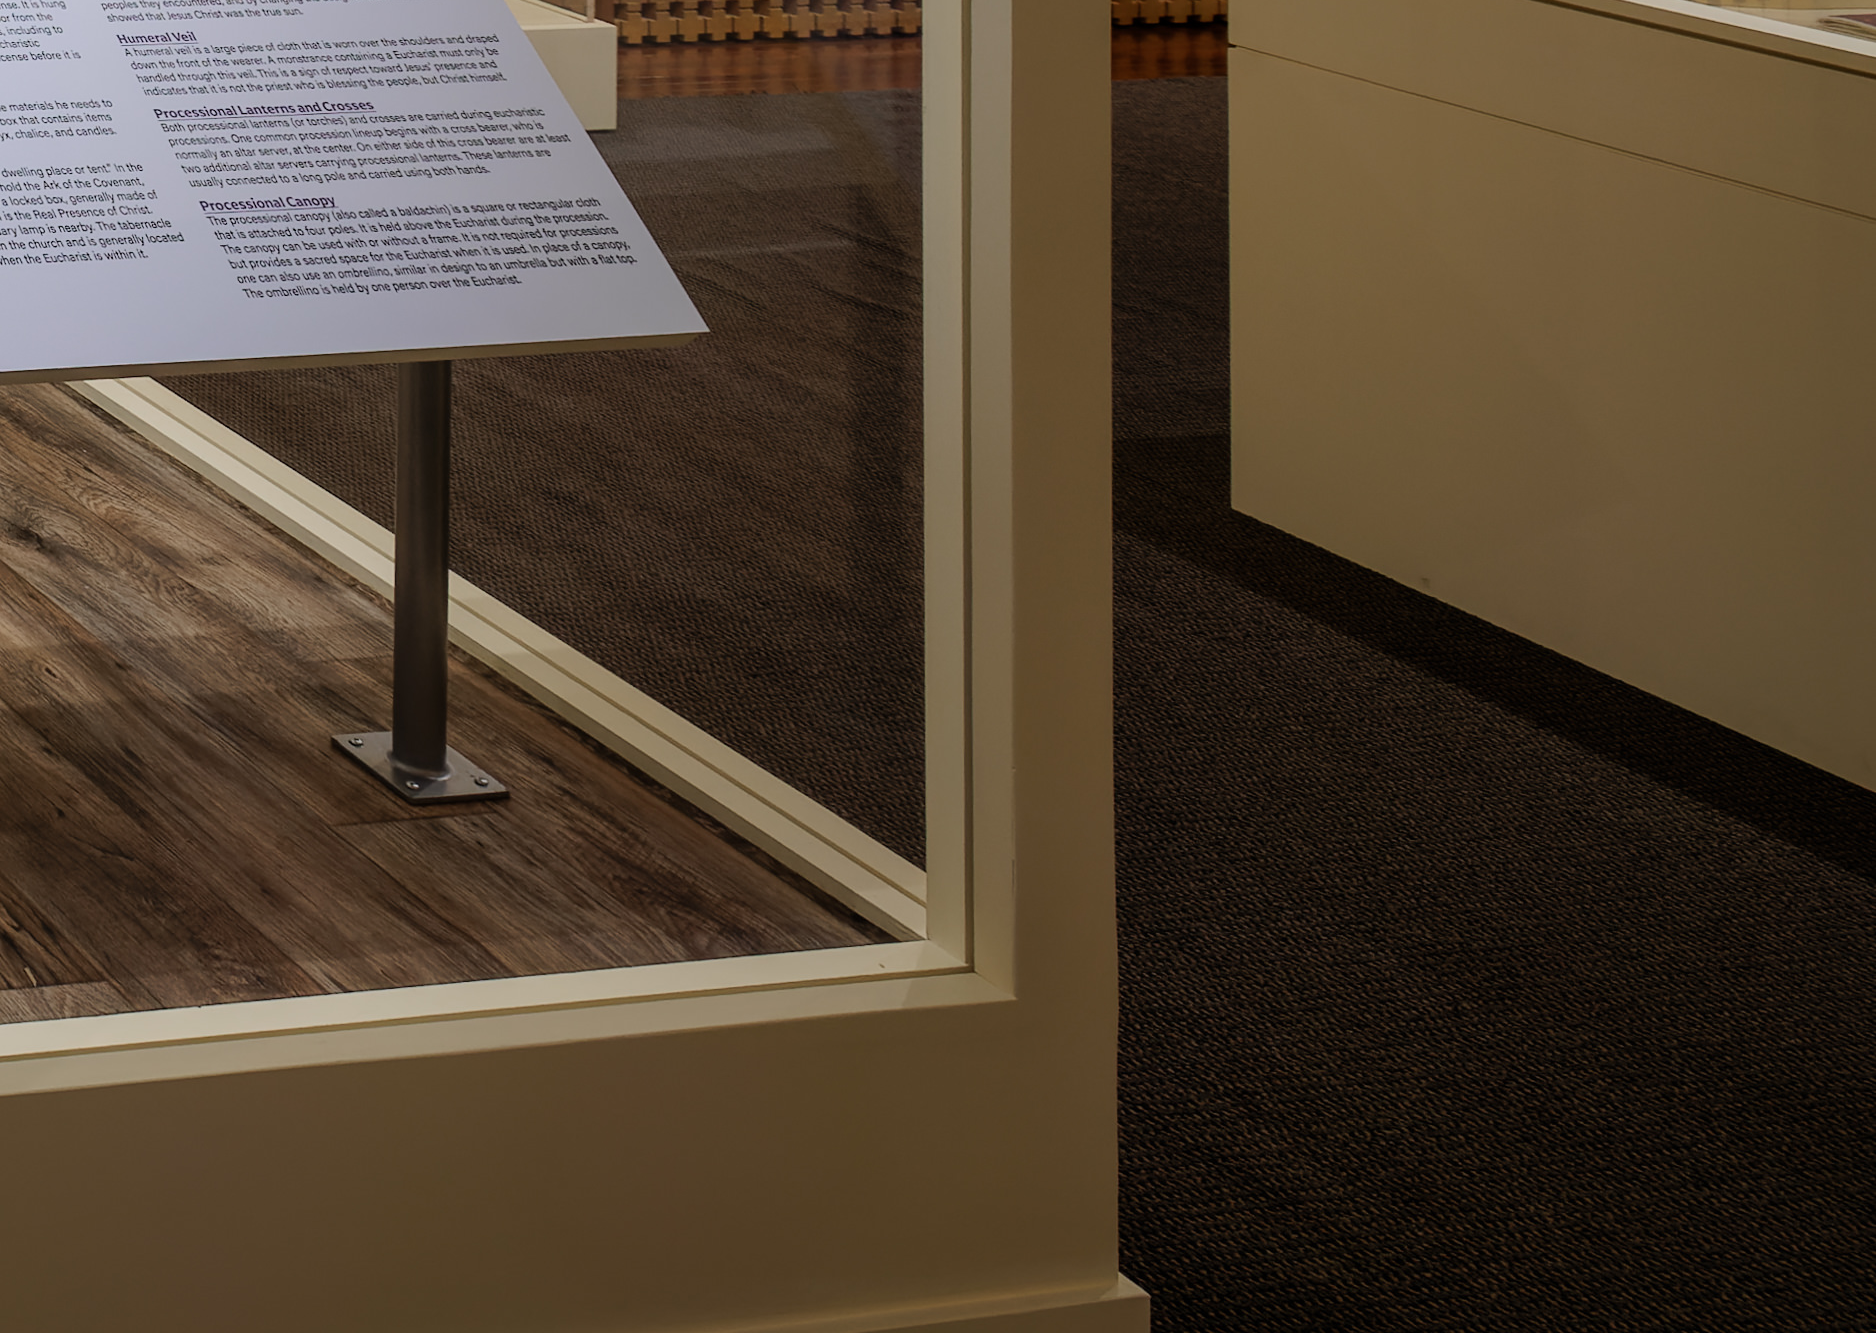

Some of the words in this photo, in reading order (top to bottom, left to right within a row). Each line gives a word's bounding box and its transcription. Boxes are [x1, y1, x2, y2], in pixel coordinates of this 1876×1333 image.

[117, 31, 172, 43] Humeral
[172, 30, 196, 41] Veil
[154, 105, 238, 119] Processional
[238, 103, 296, 115] Lanterns
[297, 102, 322, 113] and
[322, 100, 374, 112] Crosses
[199, 197, 286, 211] Processional
[286, 195, 336, 210] Canopy
